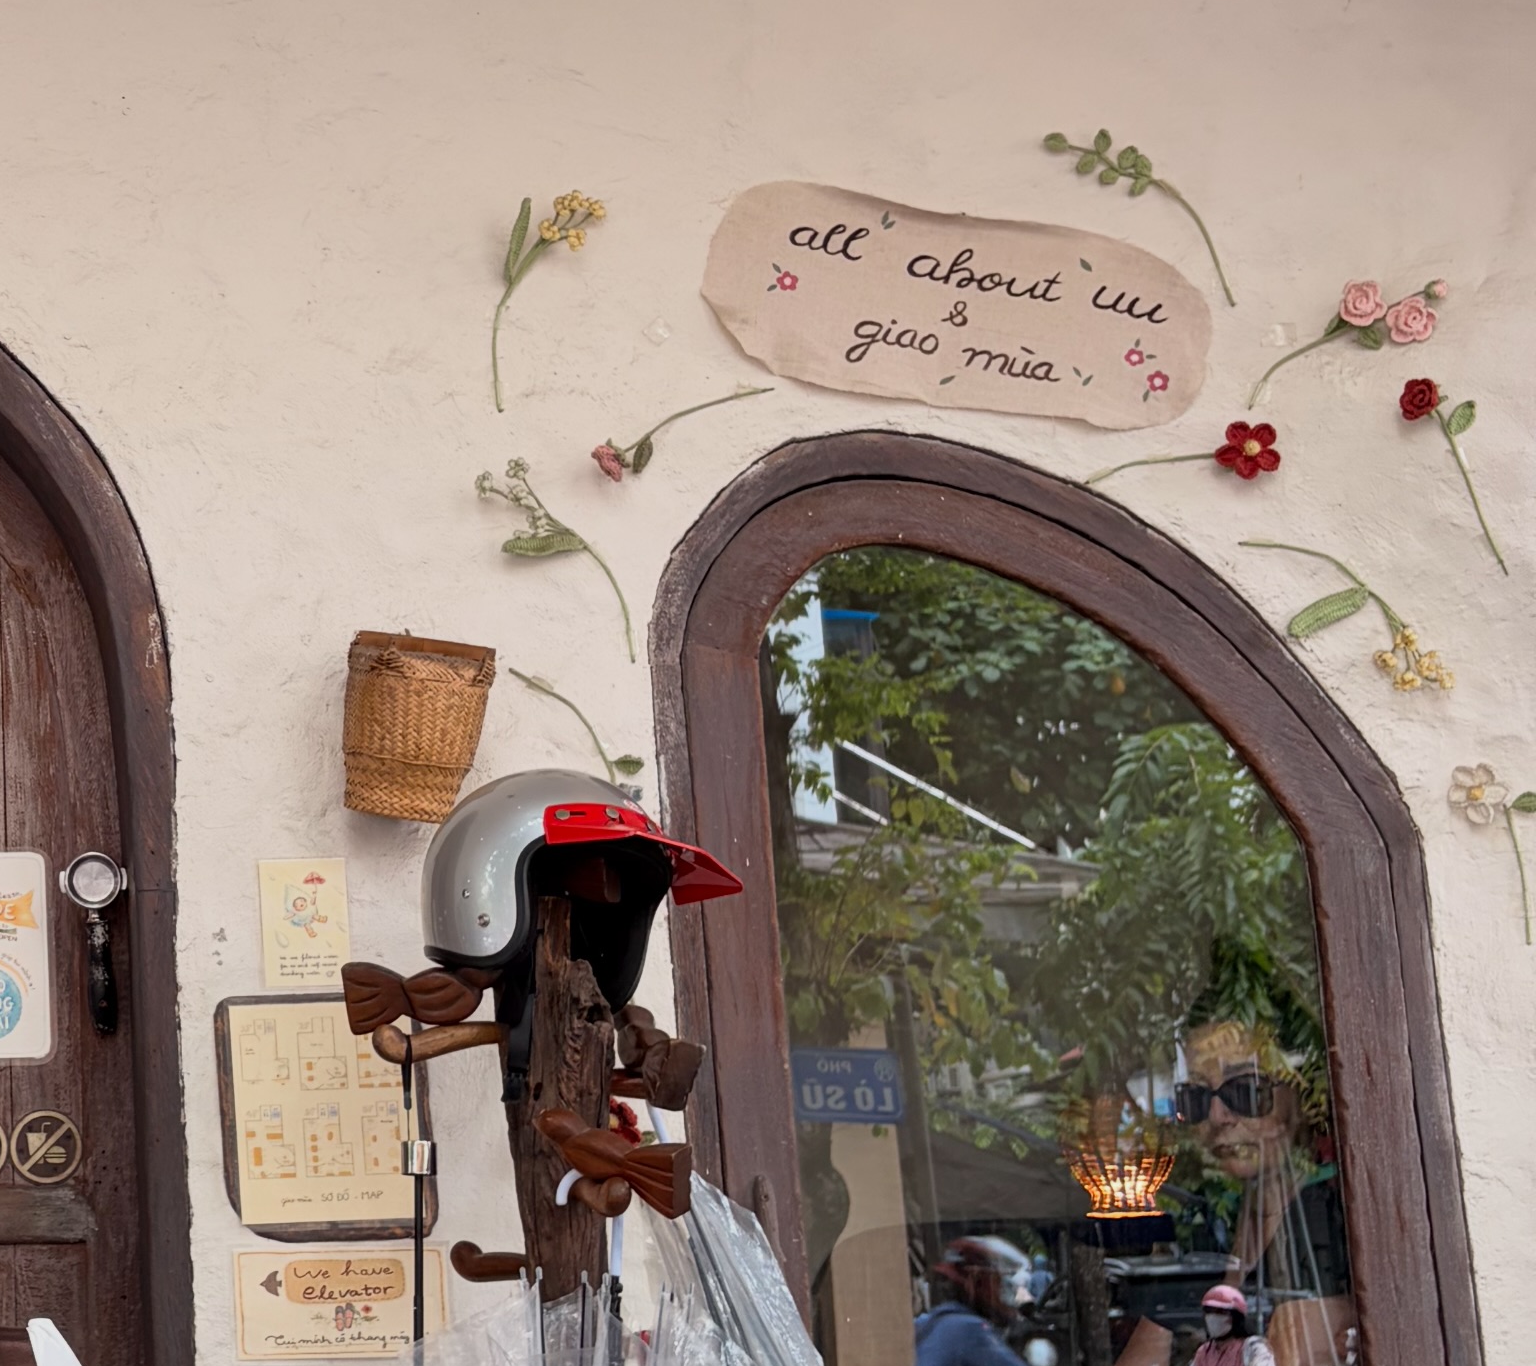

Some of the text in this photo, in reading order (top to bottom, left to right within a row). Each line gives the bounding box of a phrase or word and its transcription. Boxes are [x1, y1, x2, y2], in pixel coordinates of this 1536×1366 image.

[788, 222, 871, 261] all
[906, 248, 1062, 302] about
[844, 318, 1062, 383] giao mùa
[361, 1189, 384, 1200] MAP
[341, 1259, 394, 1277] have
[348, 1331, 387, 1349] thang
